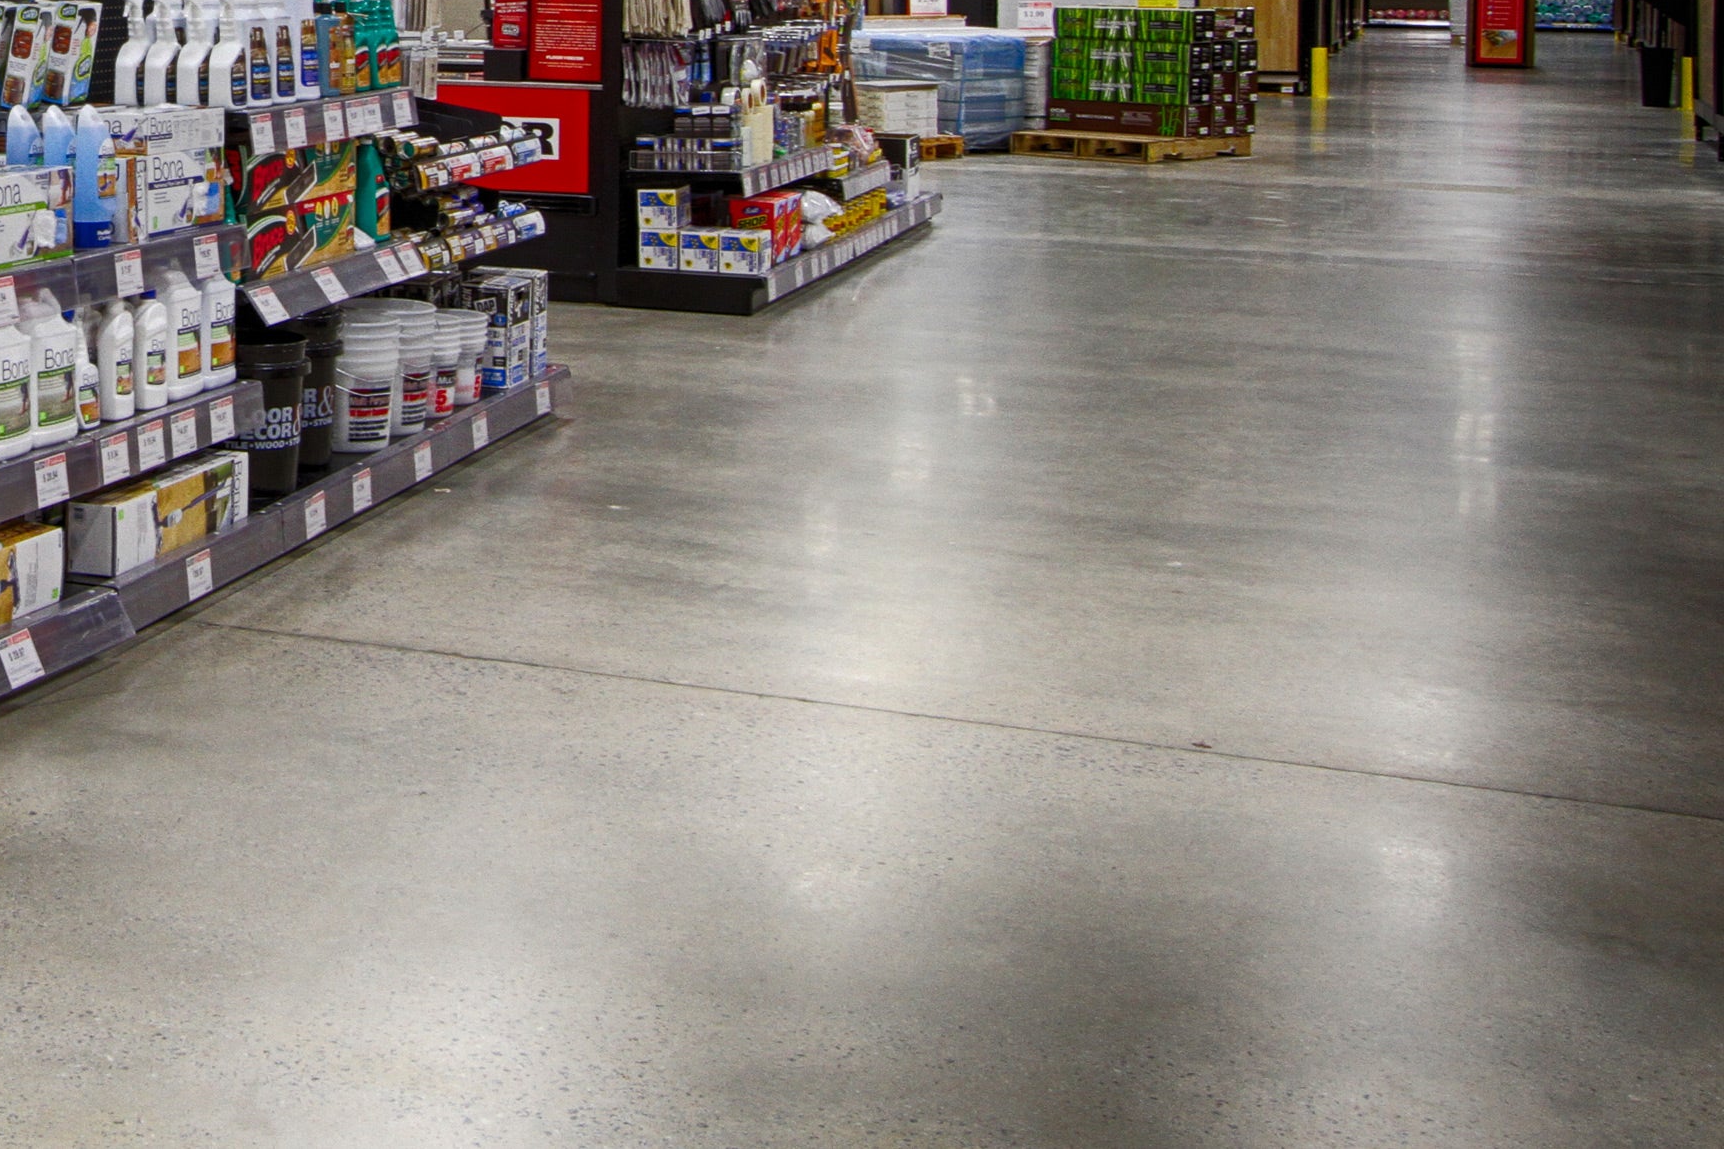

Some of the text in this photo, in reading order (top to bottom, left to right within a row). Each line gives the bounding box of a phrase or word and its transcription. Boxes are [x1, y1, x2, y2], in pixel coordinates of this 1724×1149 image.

[150, 116, 172, 135] Bona
[153, 156, 184, 182] Bona
[737, 215, 767, 229] SHOP
[476, 299, 495, 311] DAP
[44, 348, 77, 368] Bona
[2, 358, 30, 382] Bona
[436, 389, 447, 406] 5
[255, 439, 285, 449] WOOD
